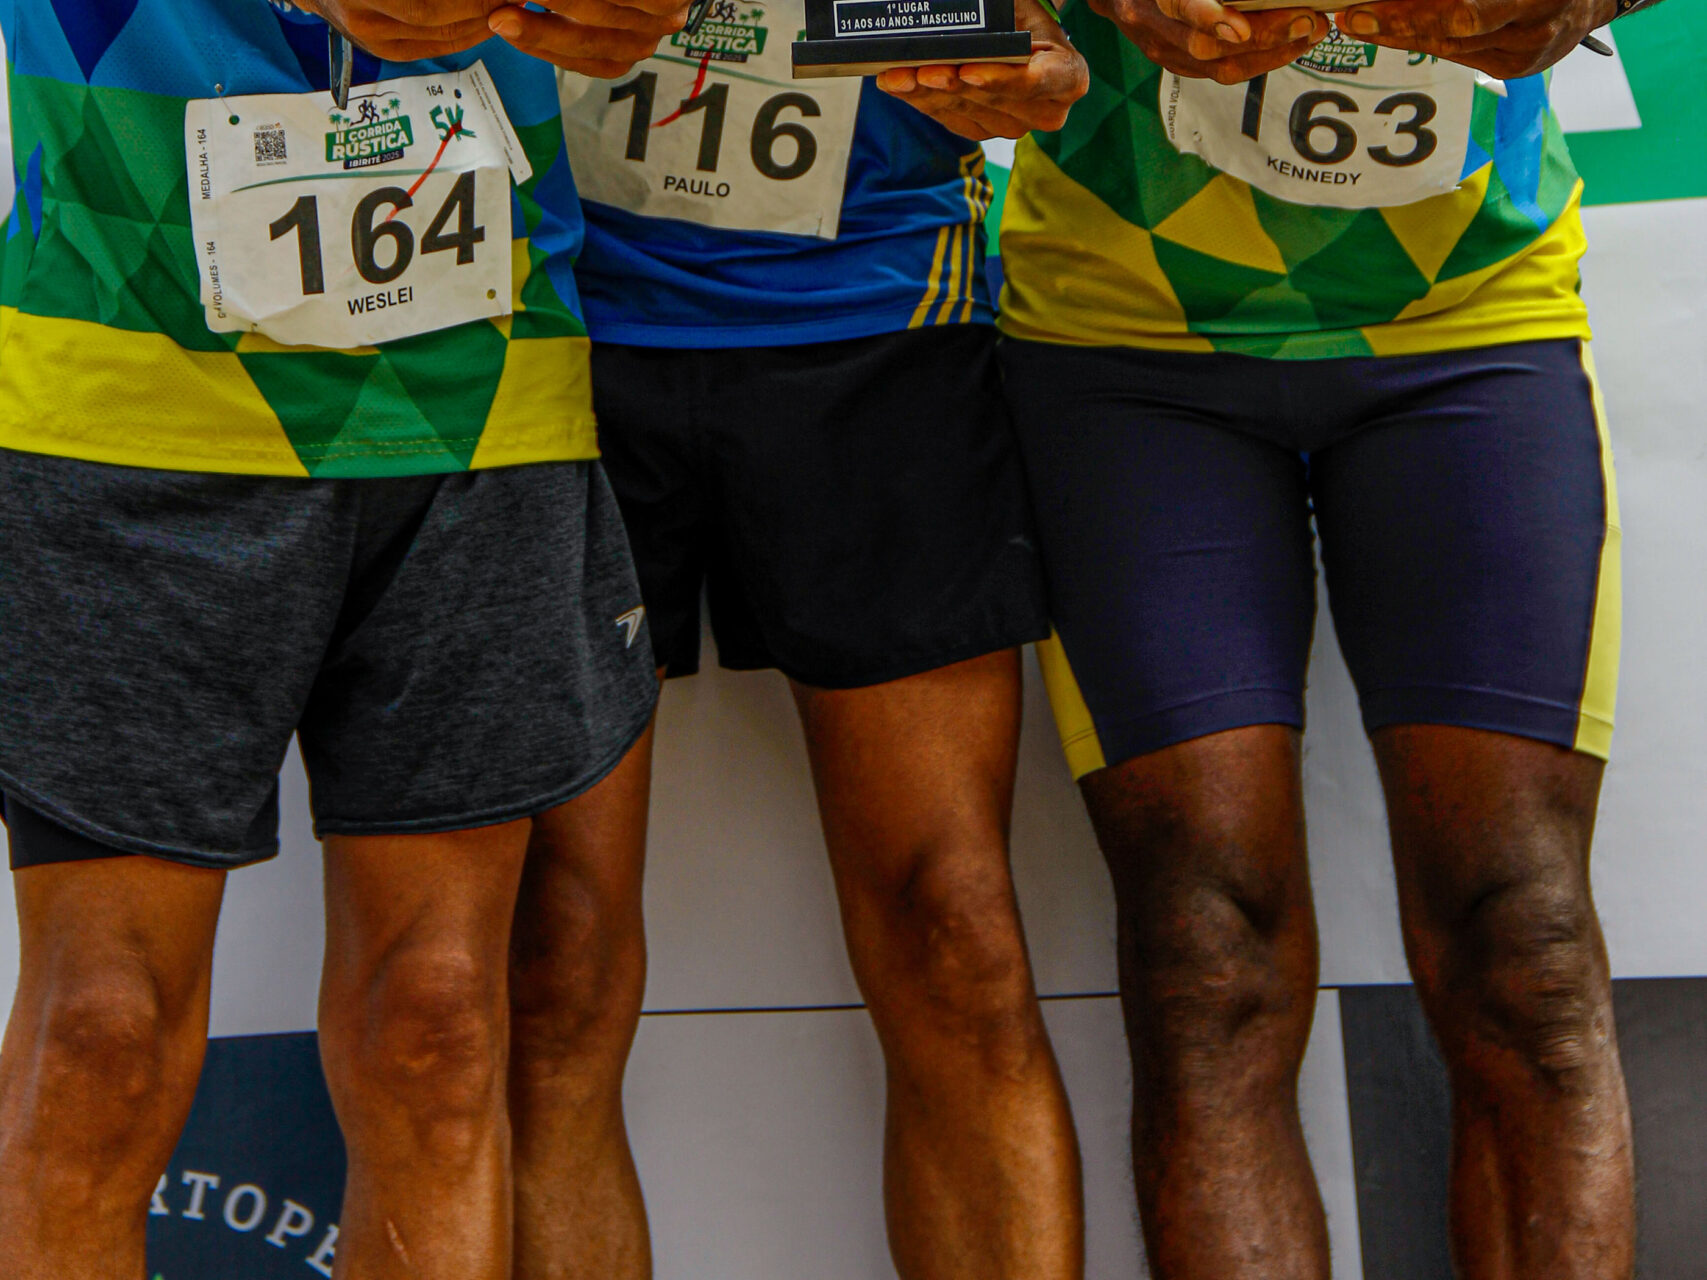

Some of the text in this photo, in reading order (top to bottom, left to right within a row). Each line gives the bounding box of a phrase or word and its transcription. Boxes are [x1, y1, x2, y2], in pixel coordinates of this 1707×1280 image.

[897, 1, 930, 13] LUGAR
[840, 19, 852, 30] 31
[854, 18, 873, 29] AOS
[875, 17, 886, 28] 40
[888, 15, 914, 27] ANOS
[921, 12, 977, 25] MASCULINO
[1315, 44, 1365, 55] ORRIDA
[426, 85, 444, 97] 164
[335, 121, 402, 144] II CORRIDA
[608, 70, 822, 181] 116
[198, 128, 207, 146] 164
[382, 150, 400, 161] 2025
[200, 152, 211, 200] MEDALHA
[1267, 156, 1363, 185] KENNEDY
[663, 175, 731, 197] PAULO
[269, 170, 485, 295] 164
[206, 241, 216, 257] 164
[209, 264, 222, 304] VOLUMES
[348, 286, 414, 316] WESLEI
